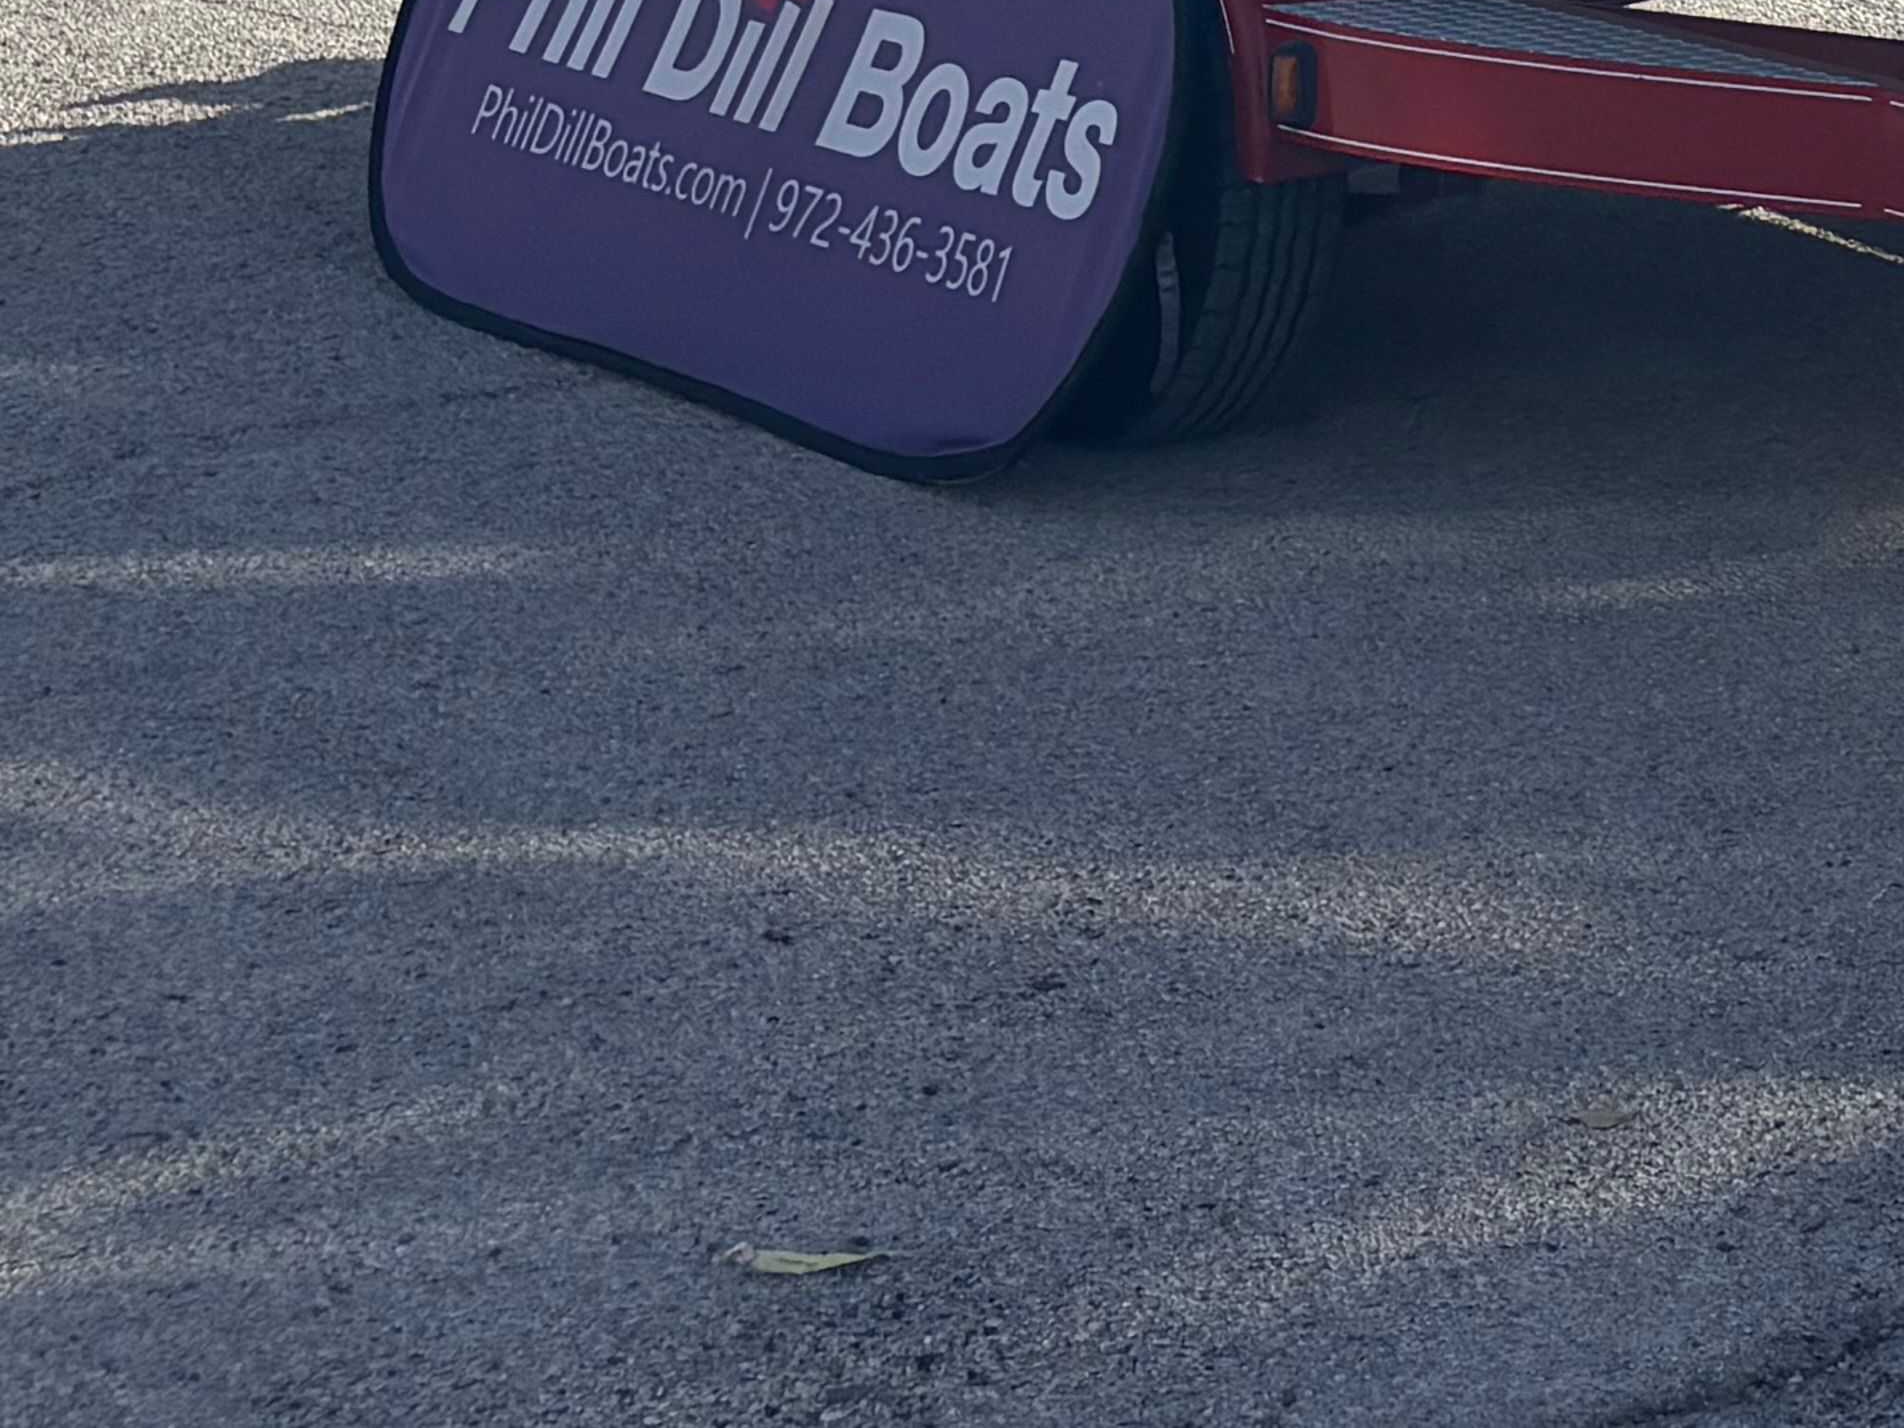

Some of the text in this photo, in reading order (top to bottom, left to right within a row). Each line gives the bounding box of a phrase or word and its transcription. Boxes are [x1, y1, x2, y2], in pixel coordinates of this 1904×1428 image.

[470, 83, 747, 218] PhilDillBoats.com
[768, 179, 1014, 303] 972-436-3581
[814, 8, 1119, 221] Boats
